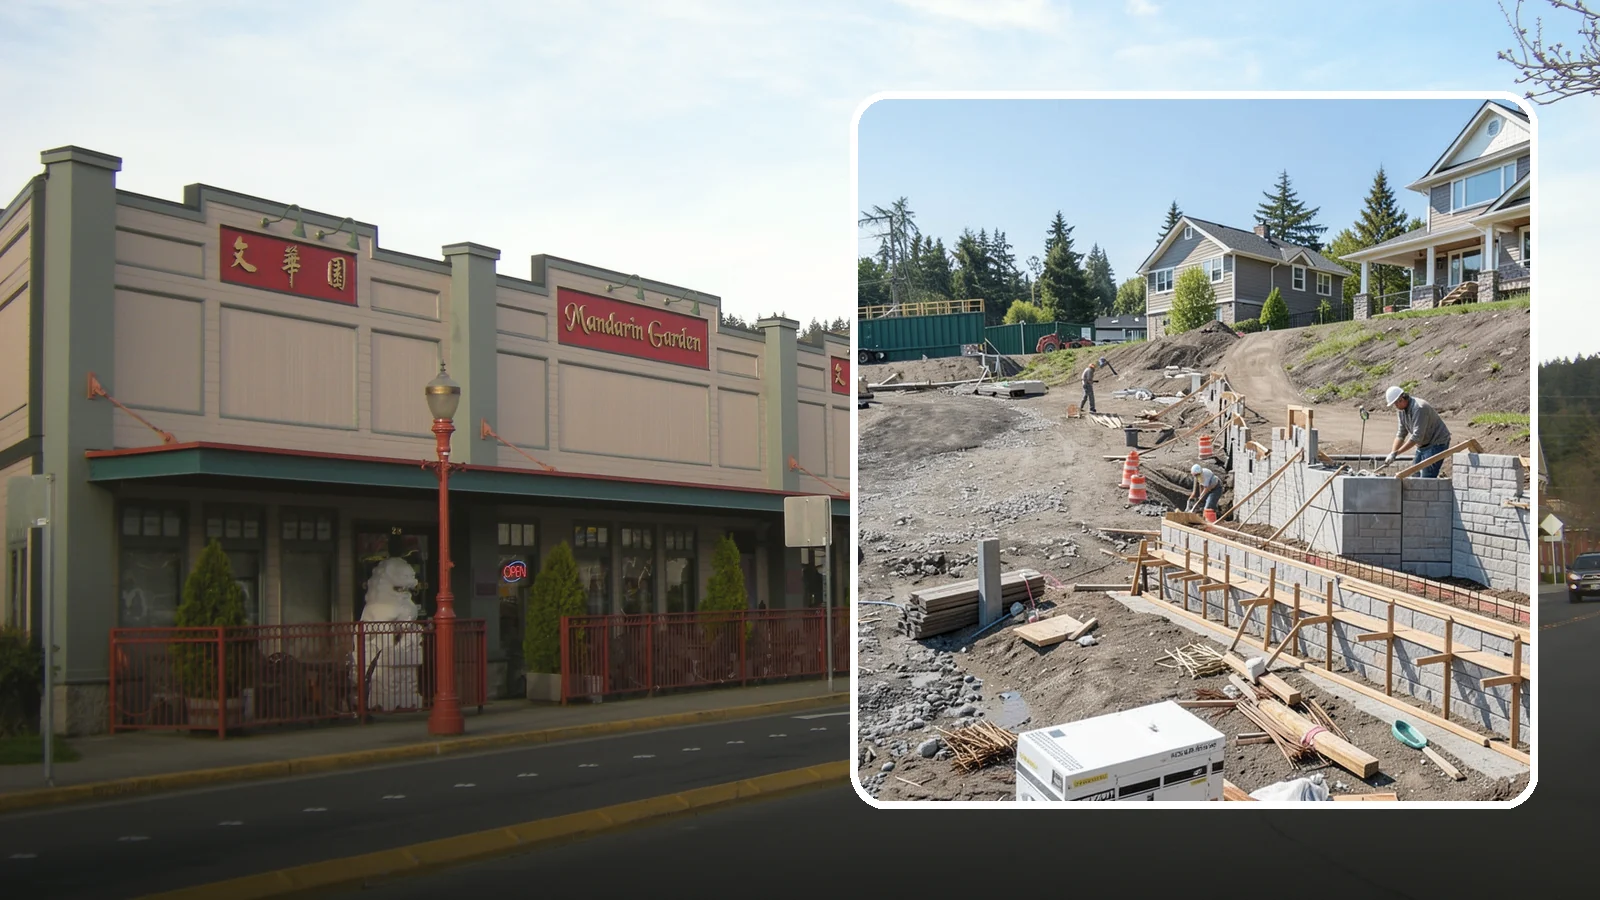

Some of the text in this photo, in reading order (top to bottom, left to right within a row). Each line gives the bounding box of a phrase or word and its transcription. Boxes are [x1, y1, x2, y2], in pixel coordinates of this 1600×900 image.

[564, 302, 701, 352] Mandarin Garden
[503, 565, 526, 578] OPEN
